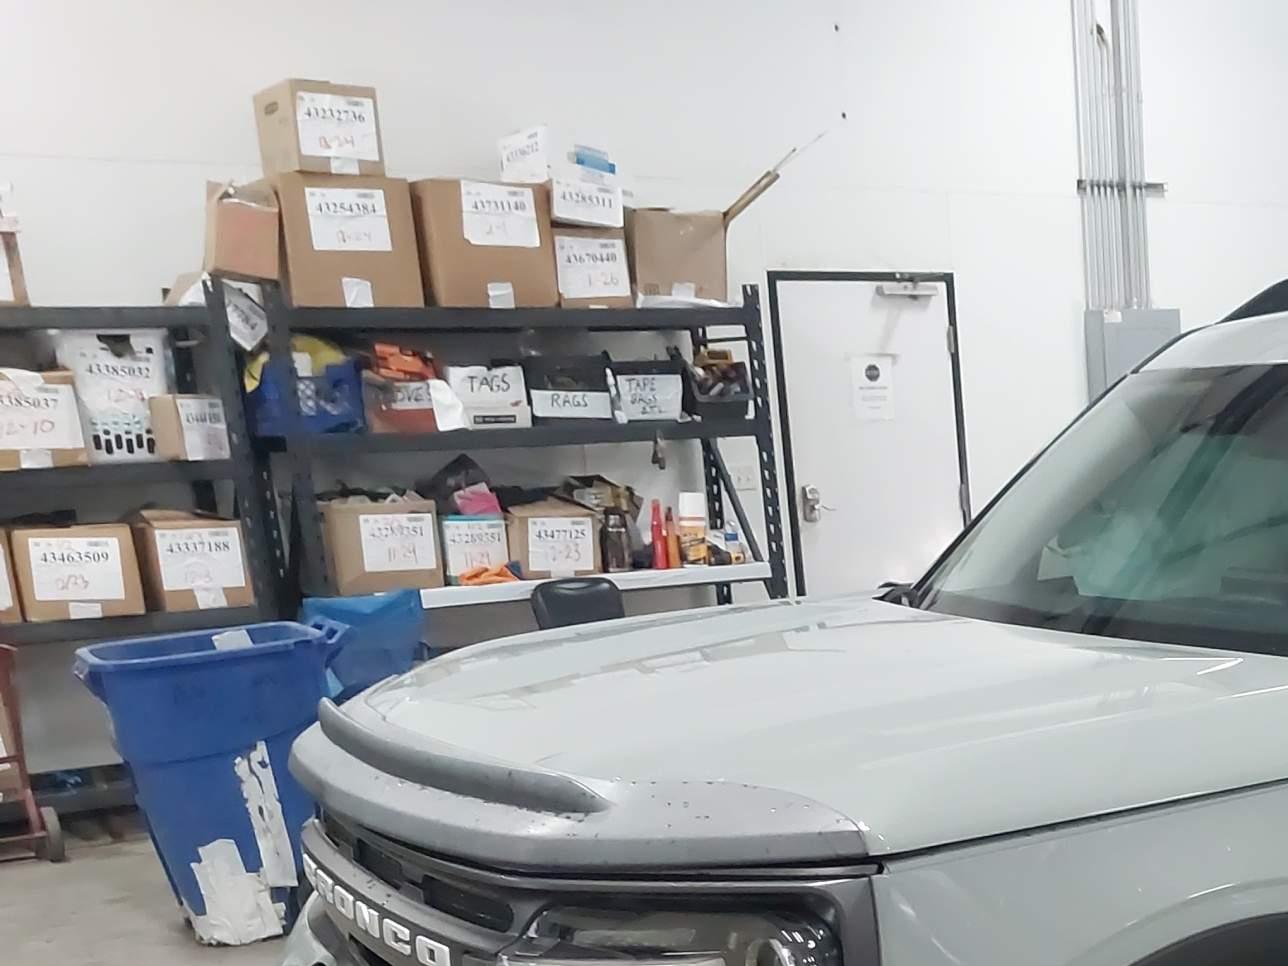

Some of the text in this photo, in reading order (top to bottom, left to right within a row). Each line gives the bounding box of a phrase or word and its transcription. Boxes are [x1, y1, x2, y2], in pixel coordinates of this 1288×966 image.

[304, 107, 366, 123] 43232736
[565, 252, 618, 264] 43670440
[86, 361, 151, 379] 43385032
[467, 373, 511, 393] TAGS
[551, 392, 589, 408] RAGS
[535, 529, 587, 540] 43477125
[166, 541, 230, 553] 43337188
[40, 551, 109, 563] 43463509
